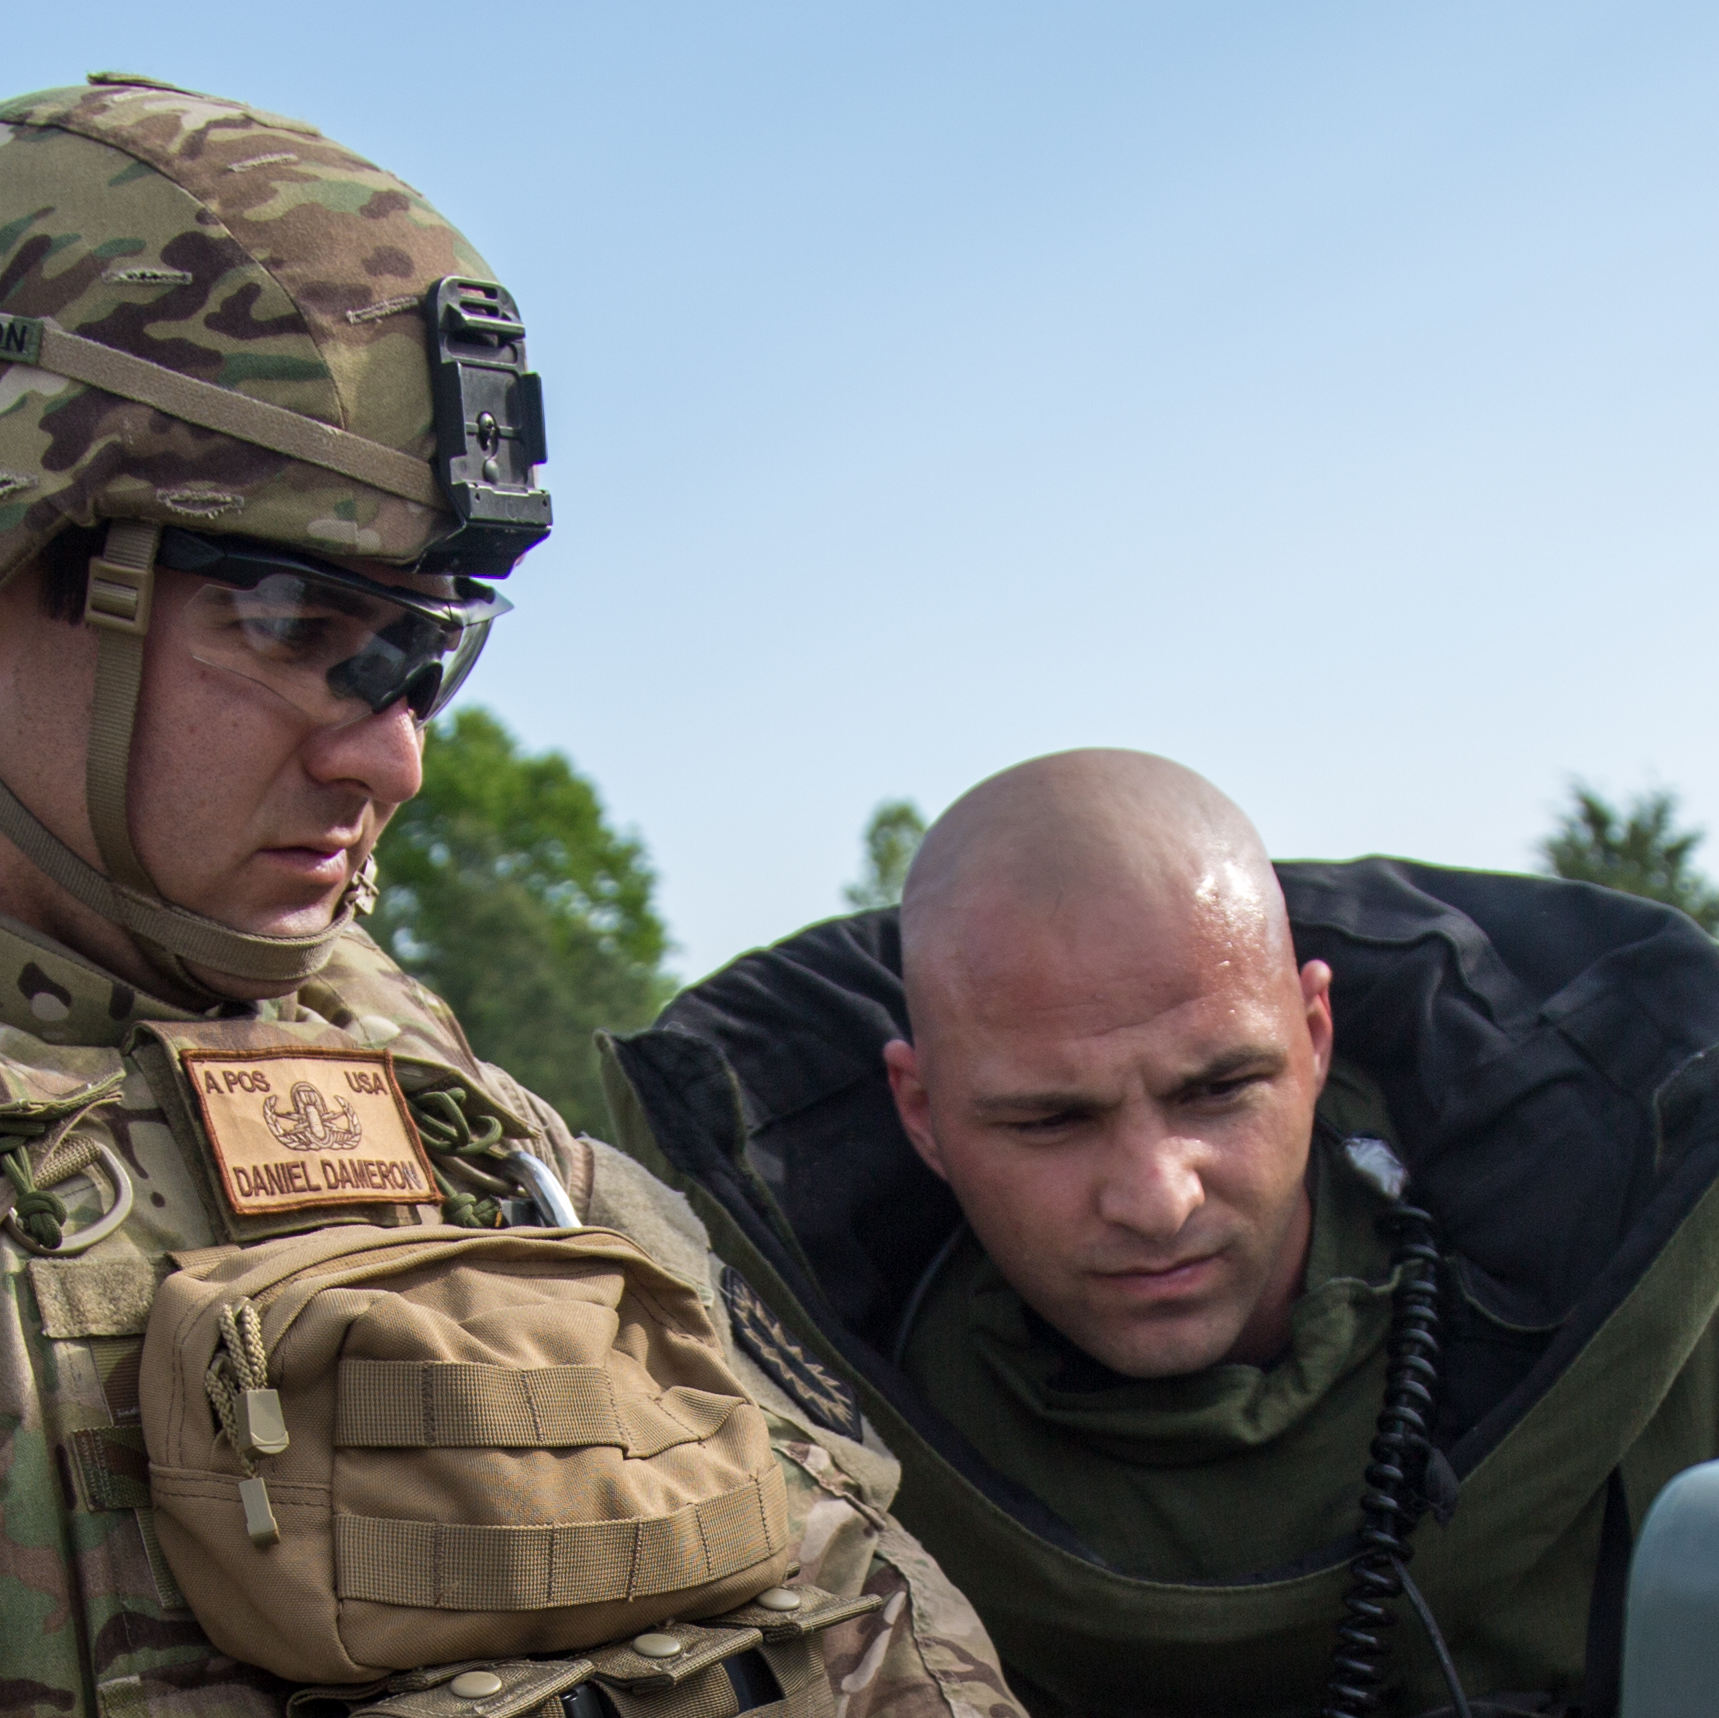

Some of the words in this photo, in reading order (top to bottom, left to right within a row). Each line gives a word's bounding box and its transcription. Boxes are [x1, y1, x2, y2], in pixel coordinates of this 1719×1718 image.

[204, 1069, 224, 1096] A
[223, 1068, 271, 1094] POS
[345, 1070, 388, 1097] USA
[233, 1161, 321, 1197] DANIEL
[322, 1157, 424, 1192] DAMERON
